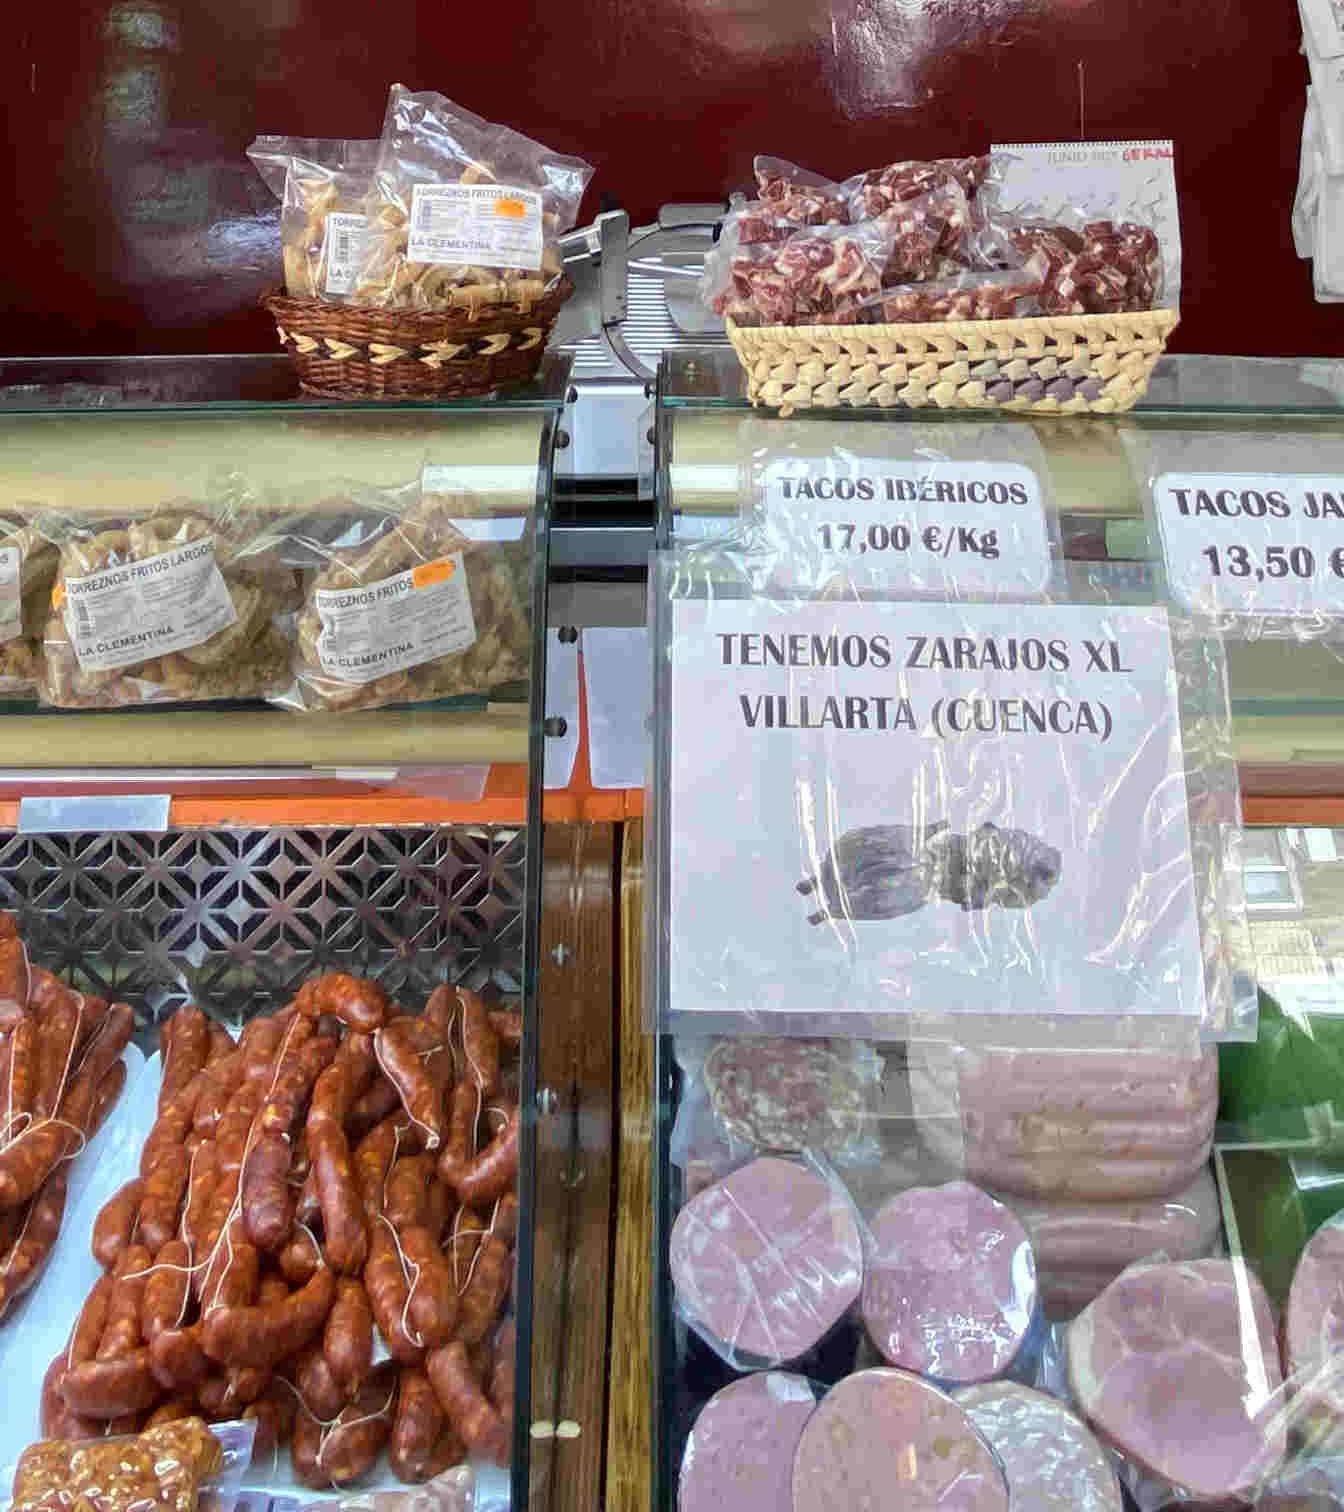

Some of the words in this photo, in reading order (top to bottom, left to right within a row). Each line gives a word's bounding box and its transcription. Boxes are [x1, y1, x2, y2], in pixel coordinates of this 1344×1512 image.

[776, 477, 875, 501] TACOS
[1168, 488, 1291, 518] TACOS
[817, 524, 912, 554] 17,00
[922, 525, 1000, 560] €/Kg
[1202, 544, 1316, 582] 13,50
[68, 571, 129, 595] ORREZNOS
[96, 625, 174, 653] CLEMENTINA
[338, 641, 414, 667] CLEMENTINA
[716, 632, 892, 669] TENEMOS
[905, 635, 1071, 673] ZARAJOS
[1080, 639, 1135, 673] XL
[739, 694, 917, 729] VILLARTA
[931, 695, 1114, 743] (CUENCA)
